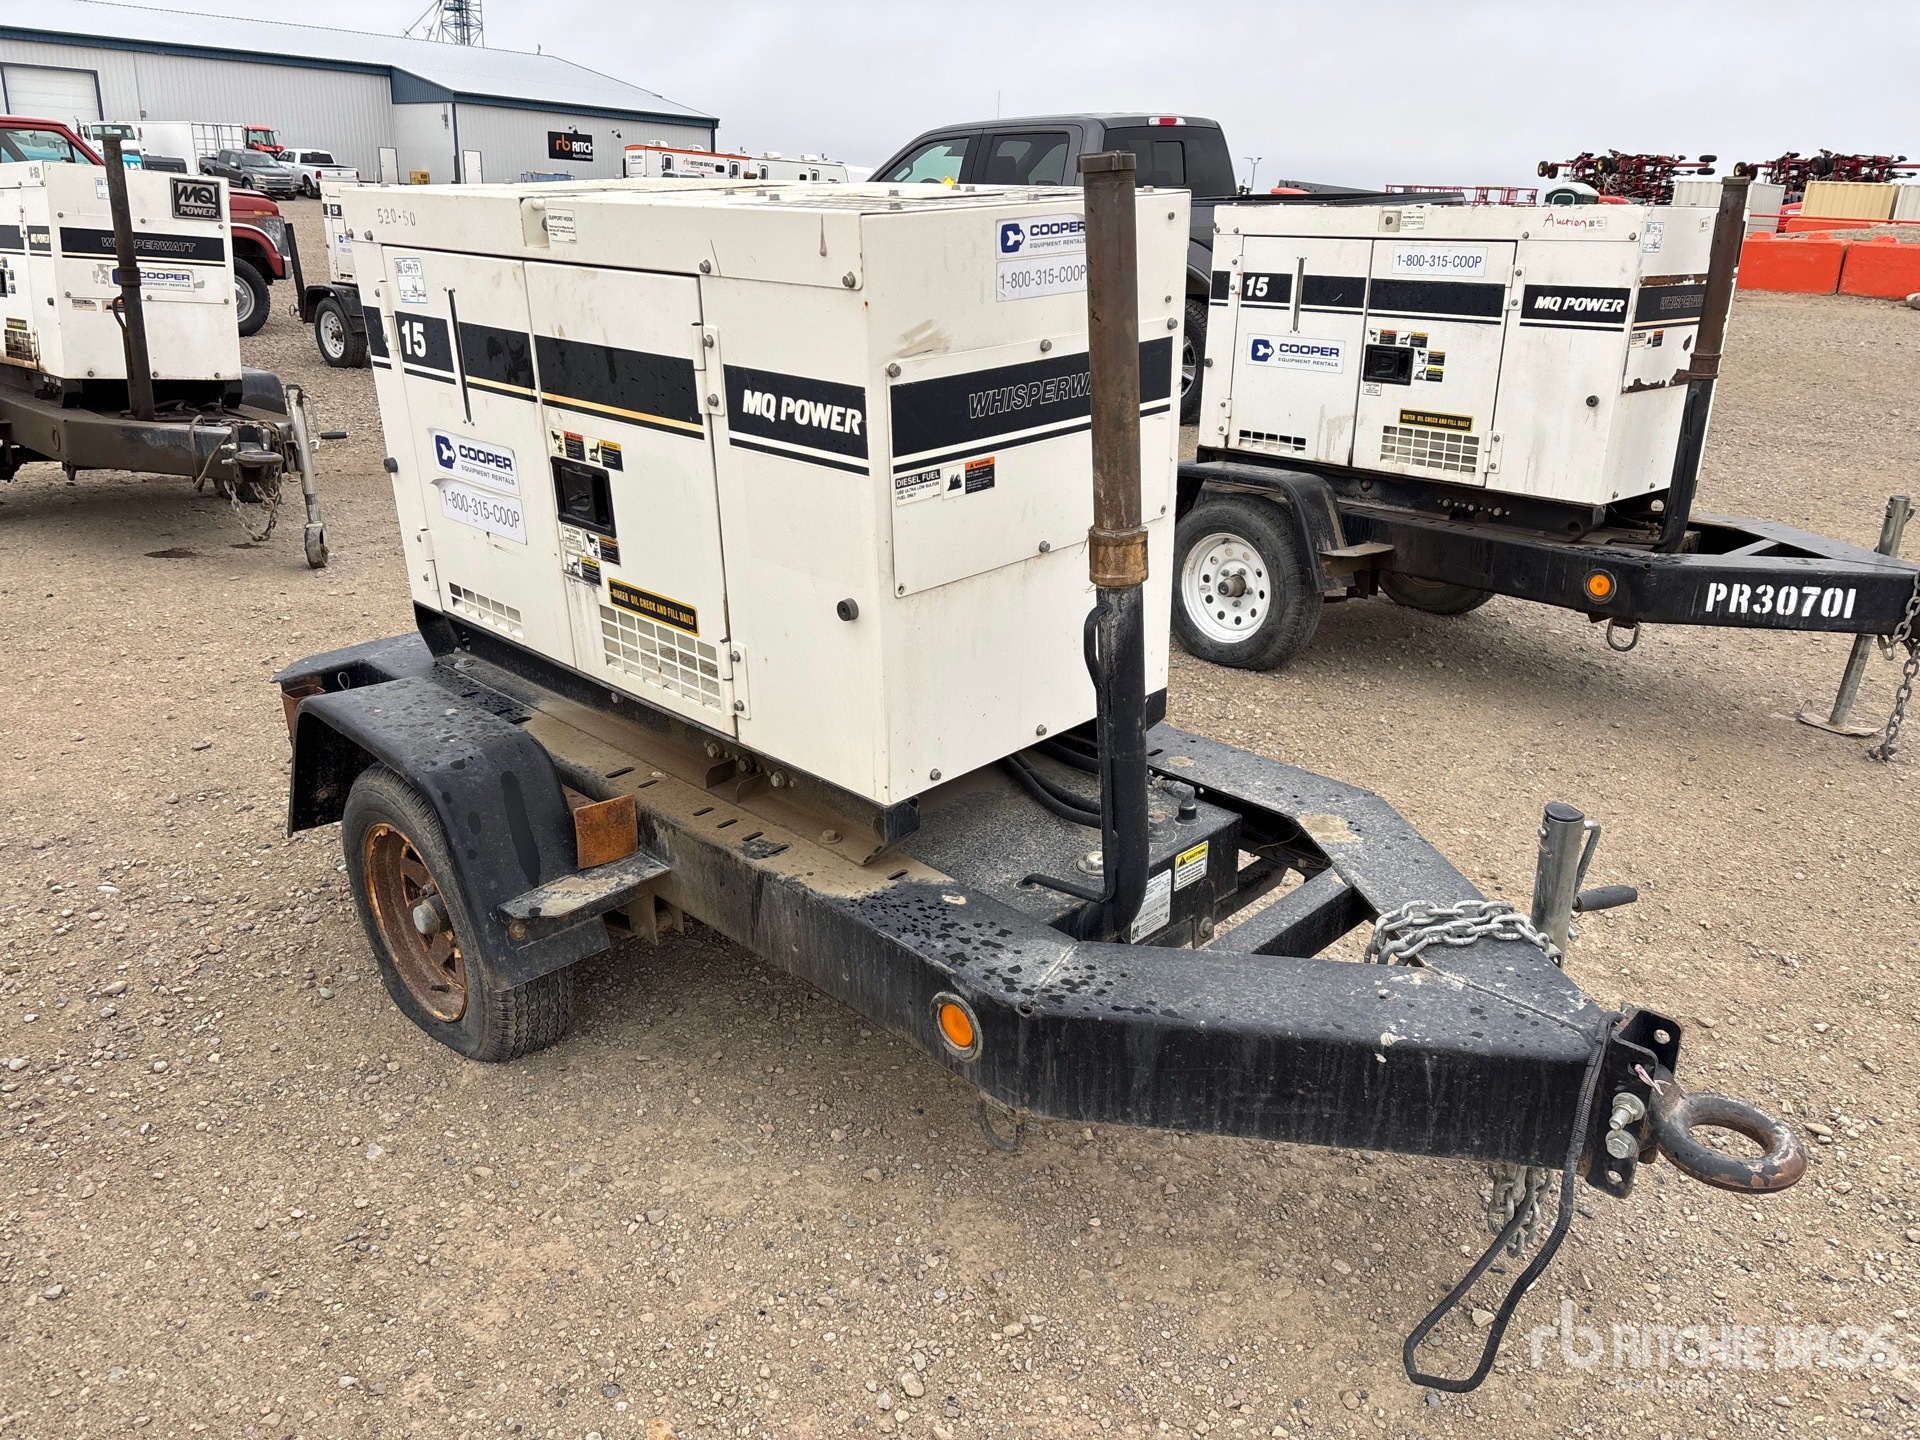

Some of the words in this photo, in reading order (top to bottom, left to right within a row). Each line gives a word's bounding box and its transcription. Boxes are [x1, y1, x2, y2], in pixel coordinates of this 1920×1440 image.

[177, 185, 215, 205] MQ
[180, 205, 217, 217] POWER
[332, 206, 339, 215] 15
[1542, 213, 1588, 228] Auction
[1030, 221, 1086, 237] COOPER
[101, 237, 196, 252] WPERWATT
[1029, 241, 1062, 249] EQUIPMENT
[1397, 254, 1482, 269] 1-800-315-COOP
[1000, 264, 1087, 290] 1-800-315-COOP
[1246, 276, 1270, 298] 15
[1534, 296, 1562, 312] MQ
[1563, 297, 1626, 313] POWER
[401, 320, 427, 358] 15
[1279, 343, 1340, 358] COOPER
[1277, 357, 1311, 365] EQUIPMENT
[1312, 360, 1339, 368] RENTALS
[742, 389, 777, 423] MQ
[780, 395, 863, 436] POWER
[1402, 413, 1415, 421] WATER
[1424, 416, 1438, 424] CHECK
[1439, 417, 1448, 425] AND
[1448, 418, 1457, 426] FILL
[1457, 419, 1470, 428] DAILY
[458, 444, 513, 472] COOPER
[461, 464, 490, 478] EQUIPMENT
[491, 473, 515, 486] RENTALS
[896, 476, 920, 488] DIESEL
[921, 470, 940, 482] FUEL
[896, 487, 904, 495] USE
[904, 485, 917, 493] ULTRA
[917, 483, 926, 491] LOW
[442, 488, 520, 529] 1-800-315-COOP
[630, 594, 640, 606] OIL
[639, 597, 657, 612] CHECK
[657, 603, 667, 616] AND
[667, 607, 680, 621] FILL
[679, 611, 694, 626] DAILY
